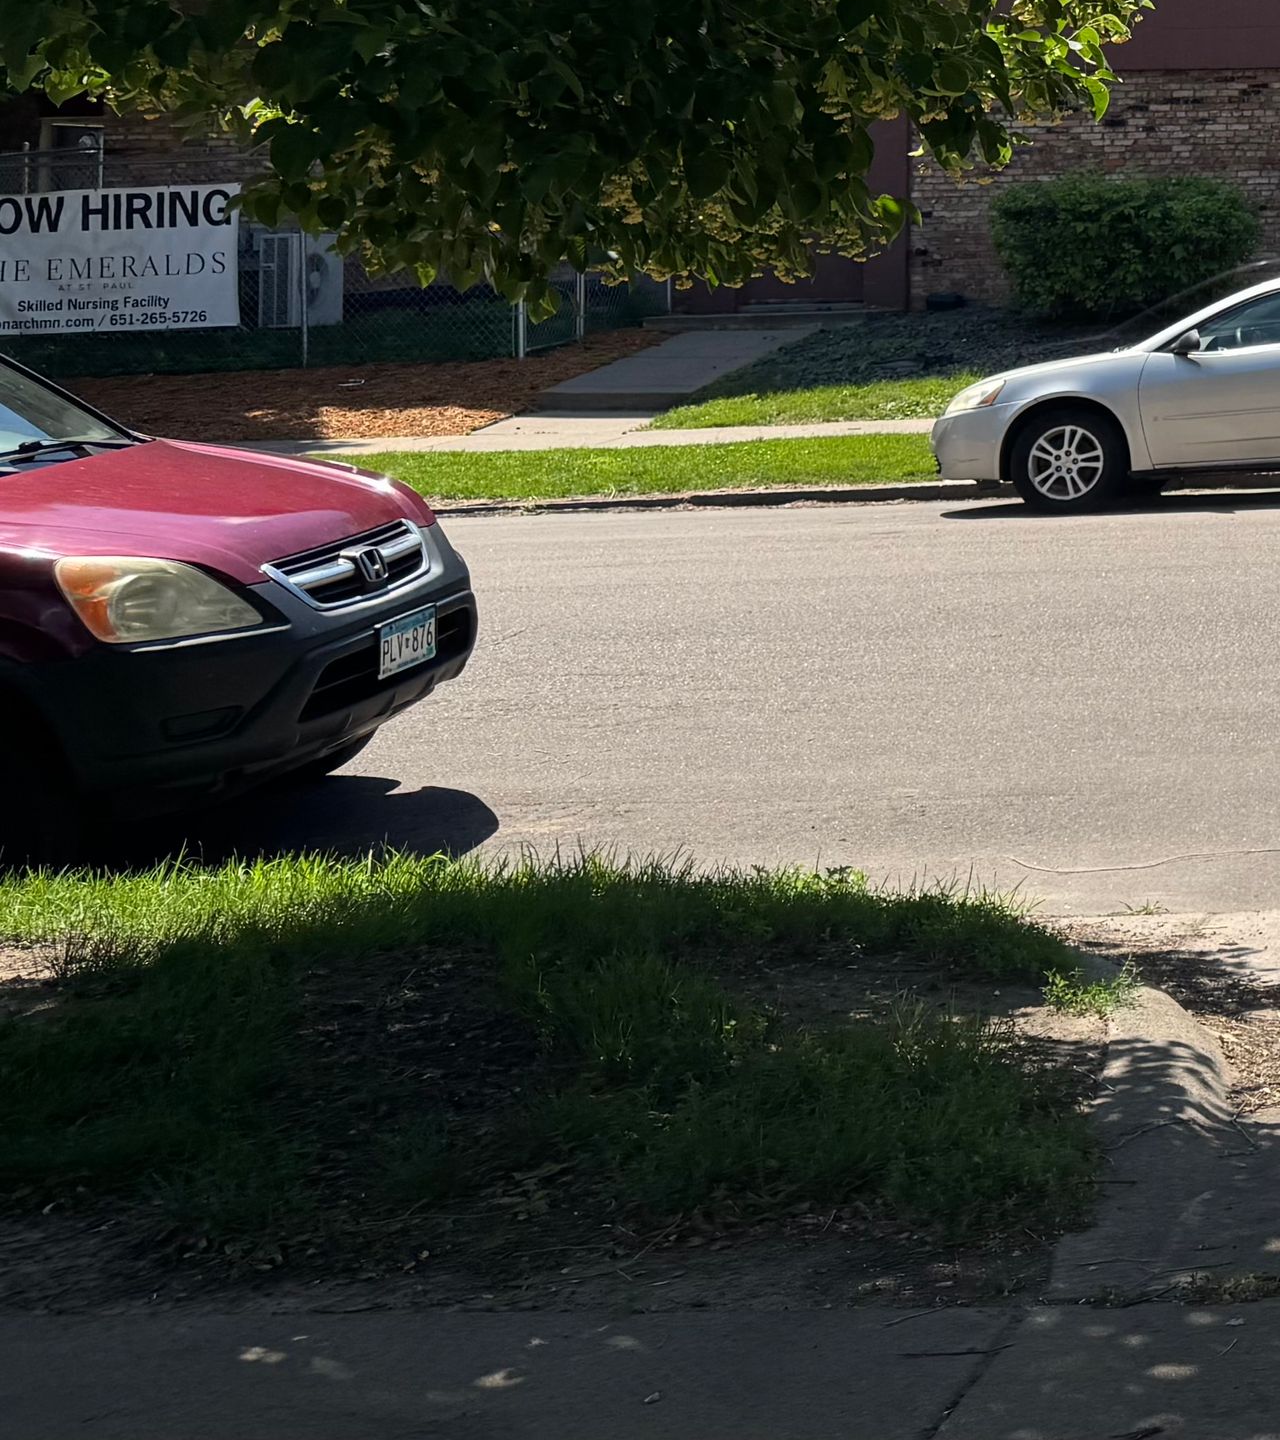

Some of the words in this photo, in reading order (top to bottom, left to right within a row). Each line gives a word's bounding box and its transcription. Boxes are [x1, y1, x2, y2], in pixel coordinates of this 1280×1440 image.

[81, 189, 232, 232] HIRING
[47, 251, 226, 281] EMERALDS
[17, 299, 63, 312] Skilled
[67, 297, 119, 311] Nursing
[124, 295, 170, 310] Facility
[0, 317, 94, 330] narchmn.com
[110, 310, 208, 326] 651-265-5726
